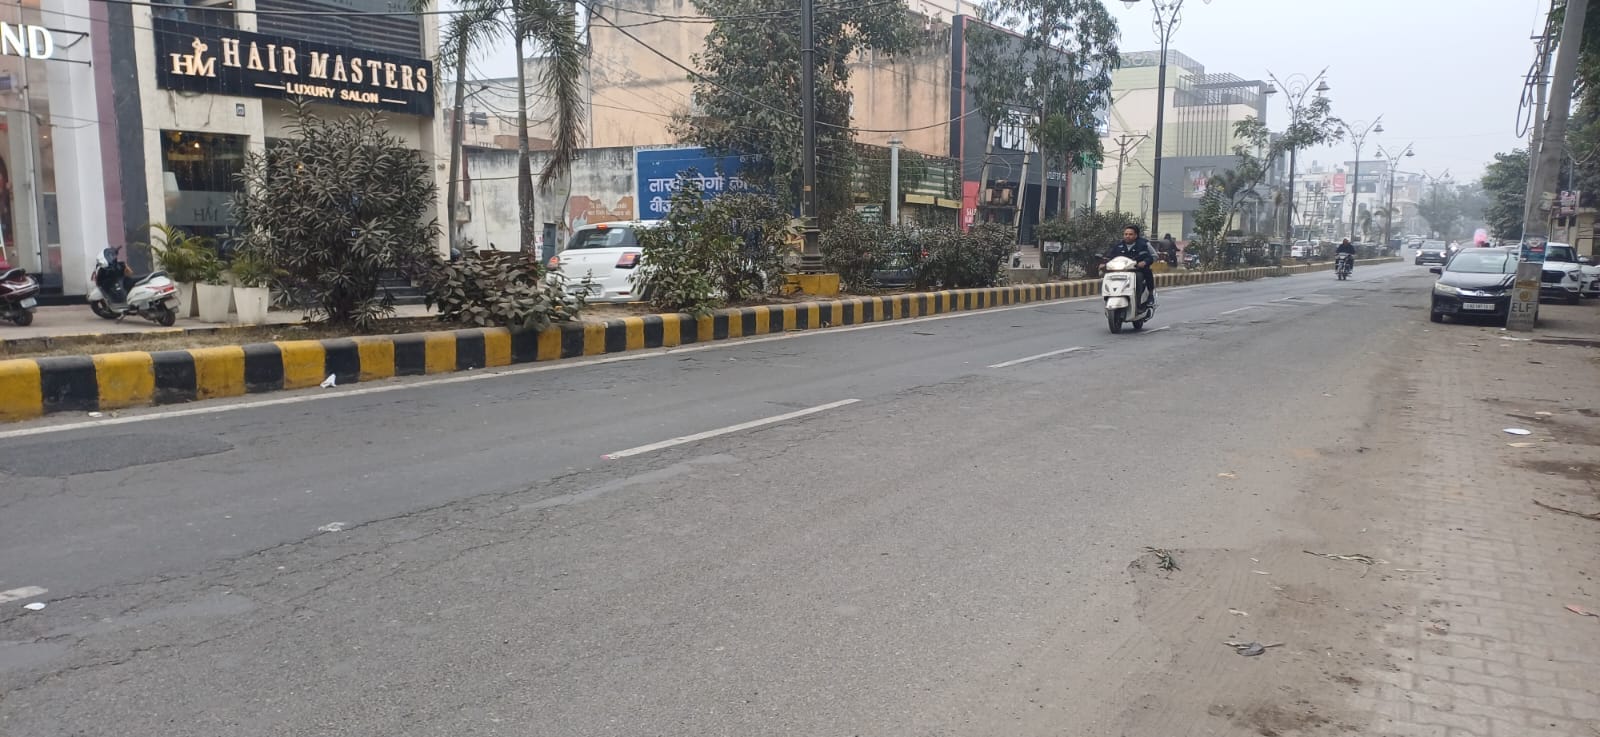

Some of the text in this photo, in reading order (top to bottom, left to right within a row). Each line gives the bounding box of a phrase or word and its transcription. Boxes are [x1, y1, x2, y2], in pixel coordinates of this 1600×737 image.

[221, 38, 428, 92] HAIR MASTERS
[286, 82, 379, 103] LUXURY SALON
